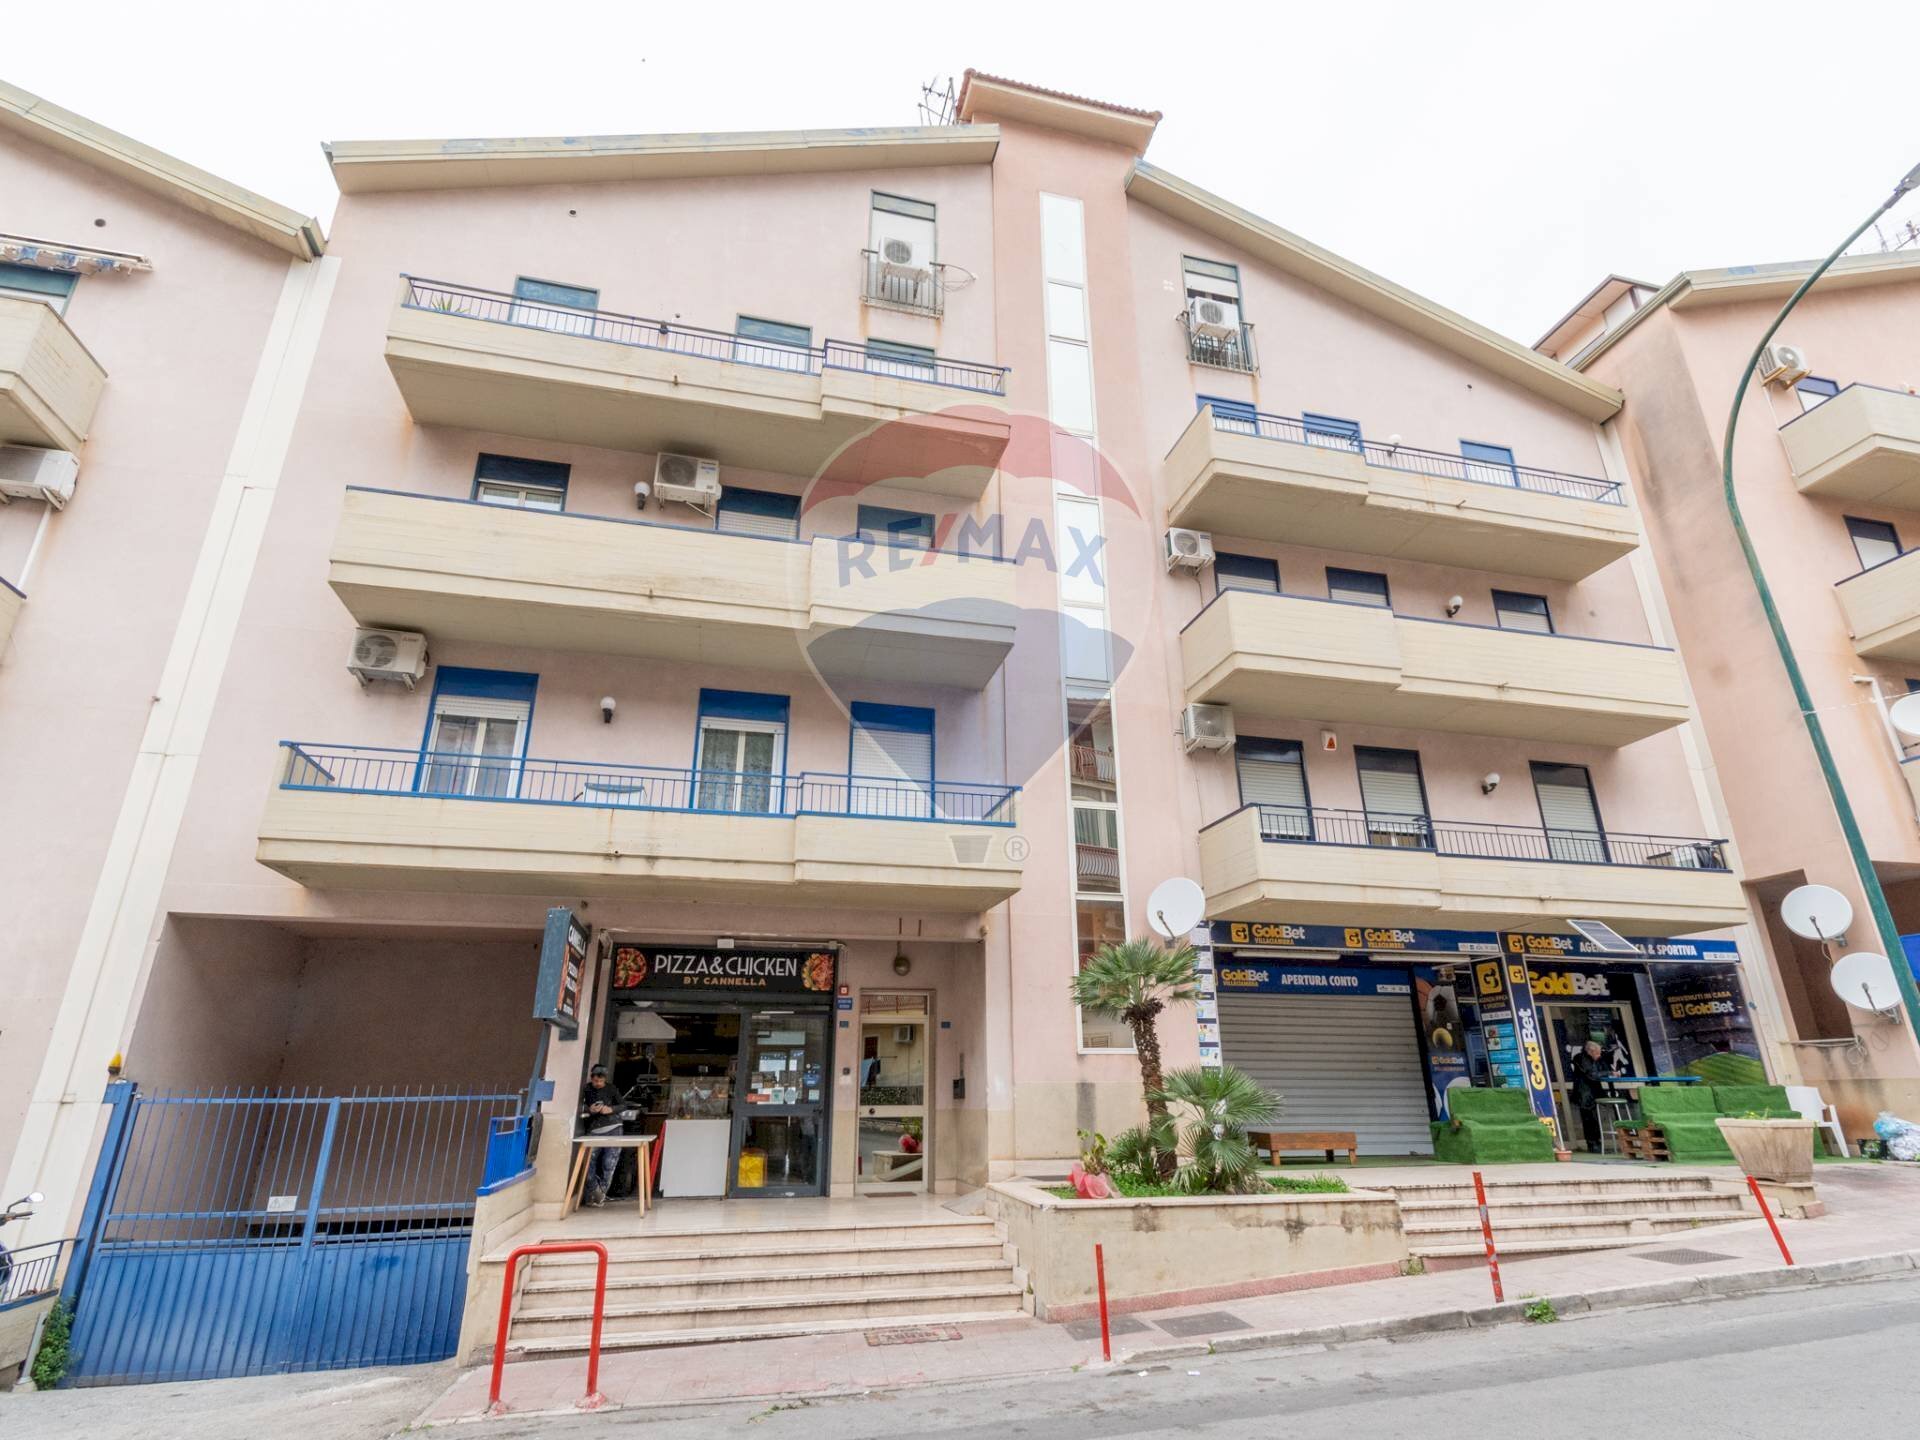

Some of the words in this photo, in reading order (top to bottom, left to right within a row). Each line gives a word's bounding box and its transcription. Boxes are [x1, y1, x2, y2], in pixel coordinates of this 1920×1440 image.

[1252, 924, 1306, 939] GoldBet
[1364, 928, 1416, 943] GoldBet
[1526, 935, 1574, 950] GoldBet
[1647, 945, 1656, 954] &
[1656, 944, 1698, 956] SPORTIVA
[654, 954, 797, 976] PIZZA&CHICKEN
[683, 976, 699, 985] BY
[703, 977, 767, 986] CANNELLA
[1220, 968, 1270, 982] GoldBet
[1281, 973, 1328, 986] APERTURA
[1329, 975, 1359, 987] CONTO
[1528, 971, 1610, 996] GoldBet
[1685, 1000, 1735, 1015] GoldBet
[1518, 1008, 1547, 1091] GoldBet
